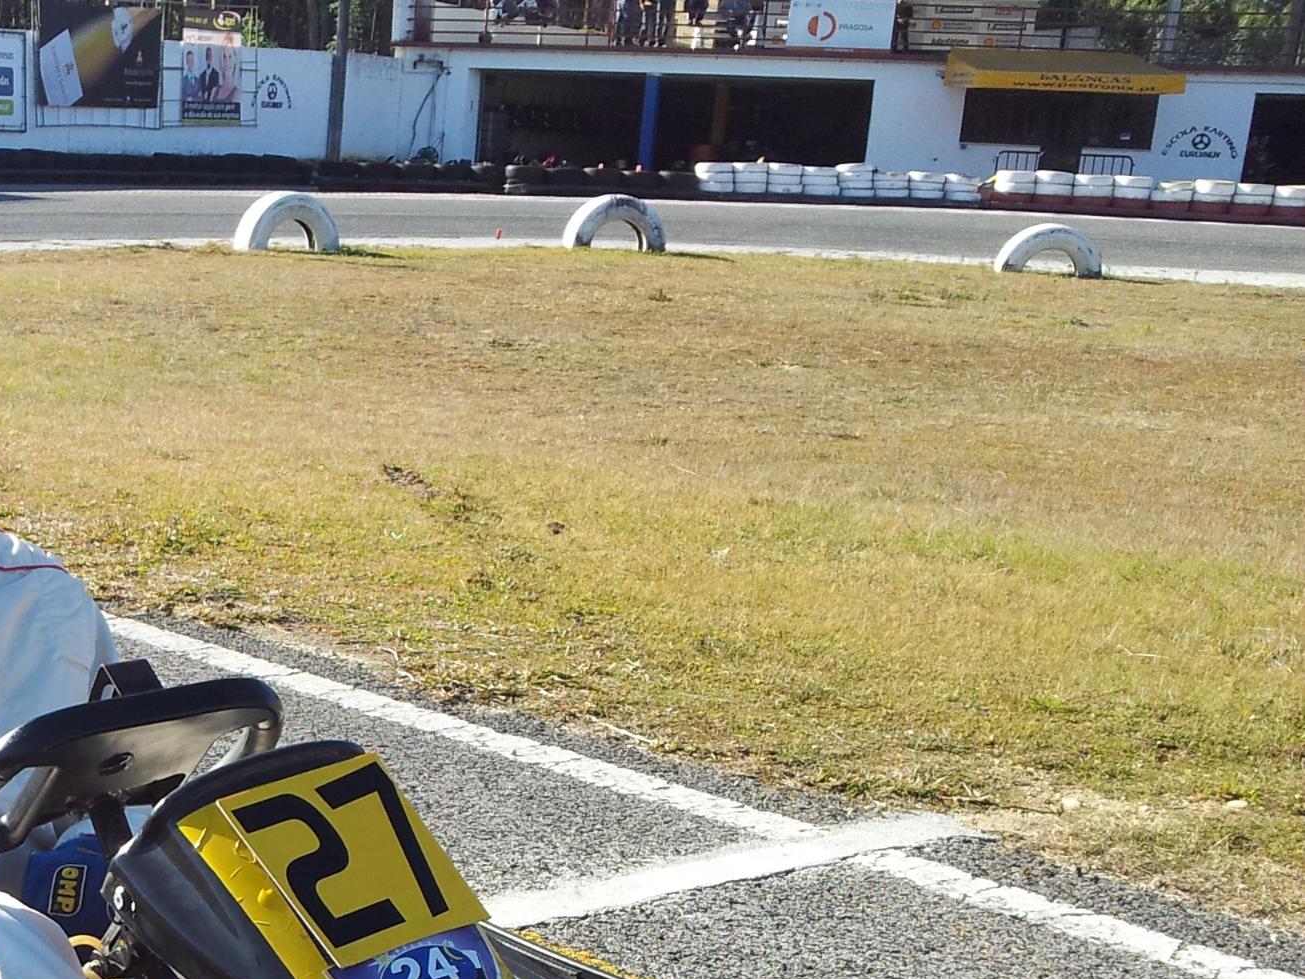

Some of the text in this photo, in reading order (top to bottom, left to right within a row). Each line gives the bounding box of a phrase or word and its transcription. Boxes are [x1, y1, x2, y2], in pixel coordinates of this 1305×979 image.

[1161, 126, 1197, 156] ESCOLA
[231, 761, 449, 948] 27
[57, 867, 80, 912] OMP
